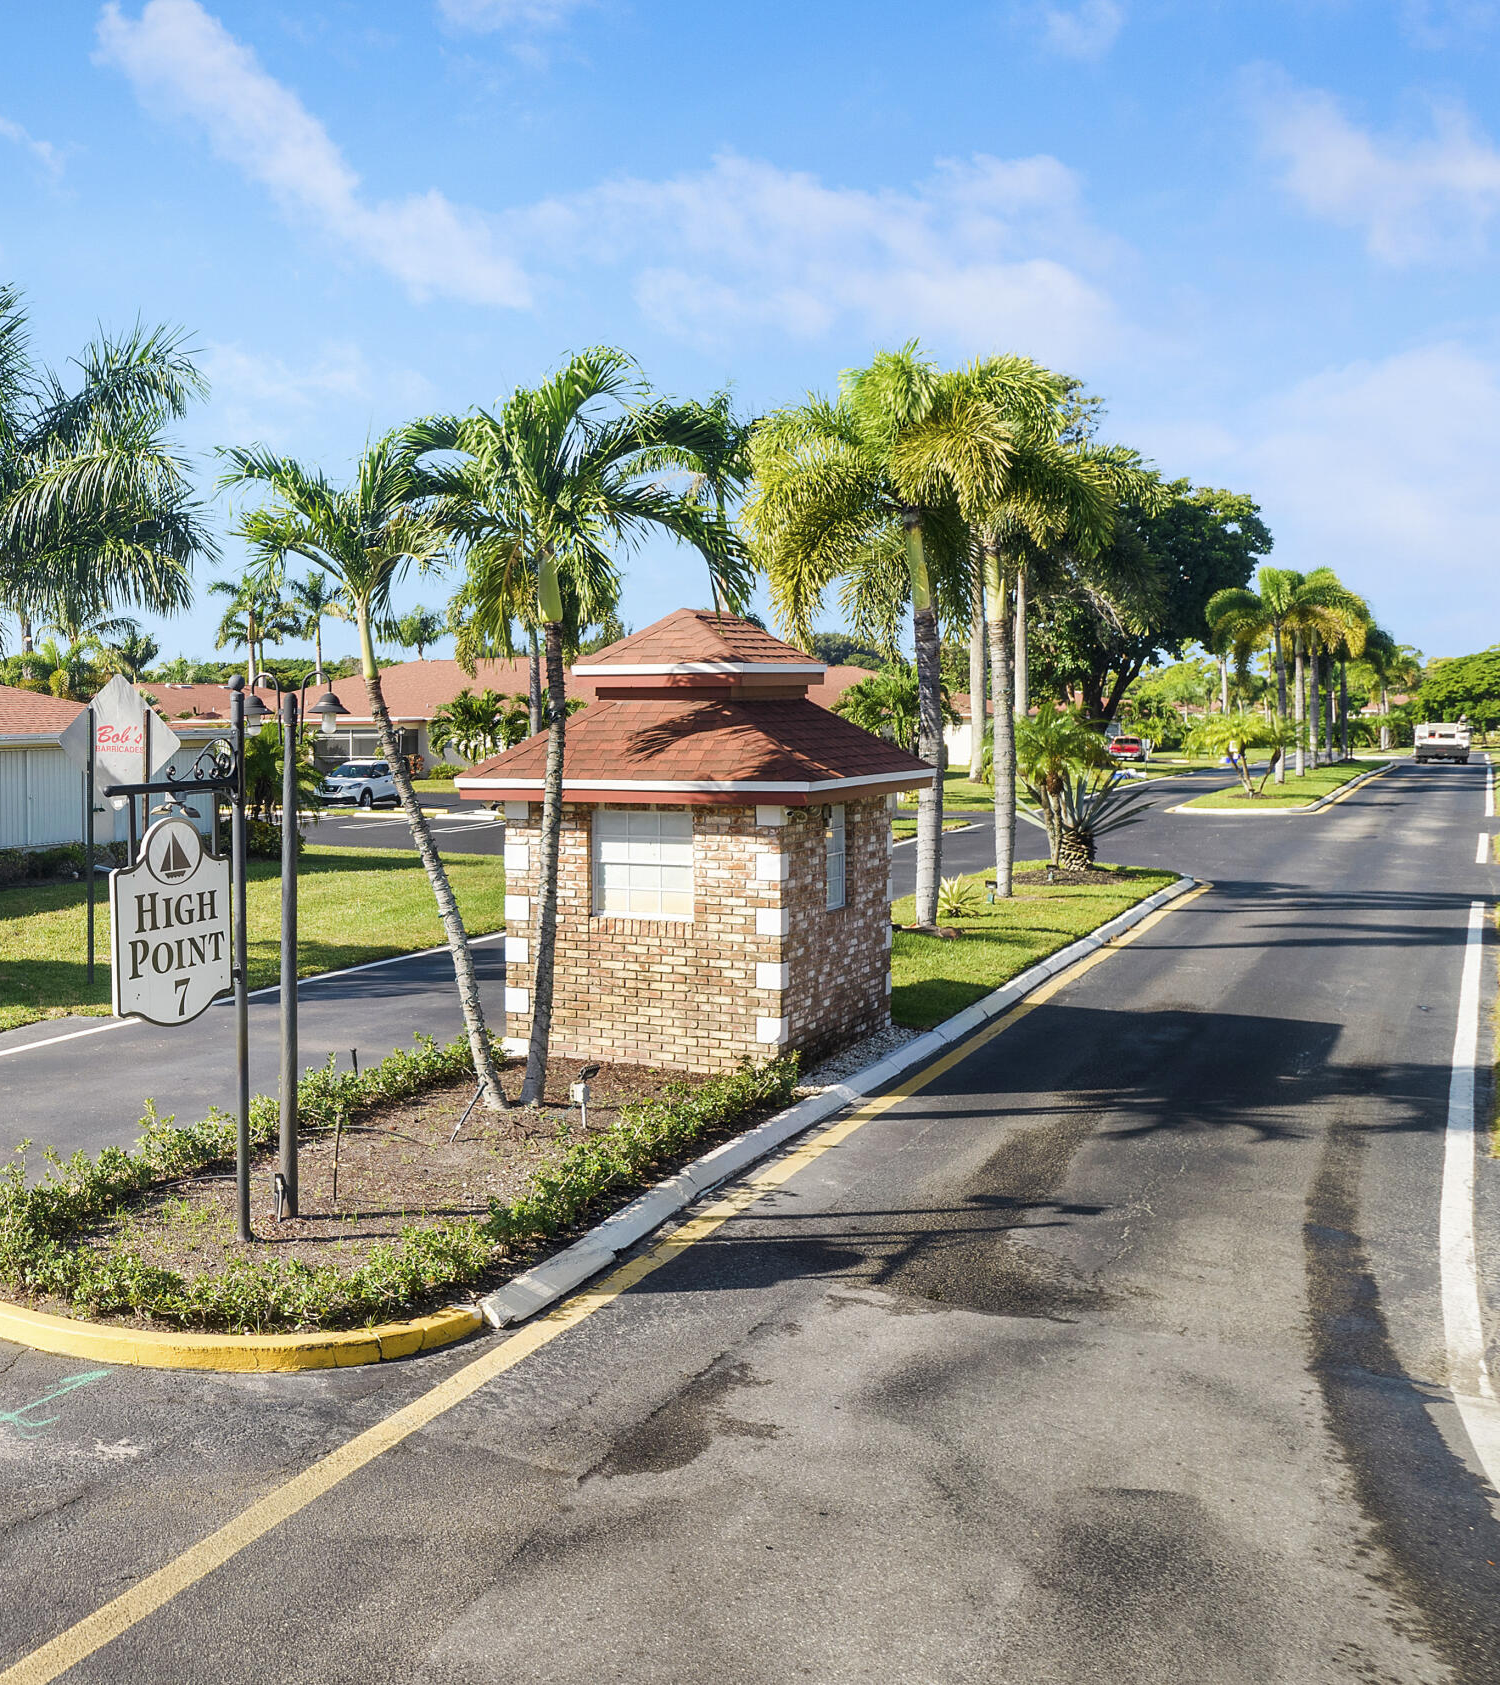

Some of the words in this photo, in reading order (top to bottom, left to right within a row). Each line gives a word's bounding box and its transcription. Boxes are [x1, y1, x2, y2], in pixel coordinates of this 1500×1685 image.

[95, 744, 145, 754] BARRICADES
[97, 724, 142, 744] Bob's
[134, 889, 218, 934] HIGH
[128, 930, 225, 980] POINT
[174, 977, 191, 1017] 7
